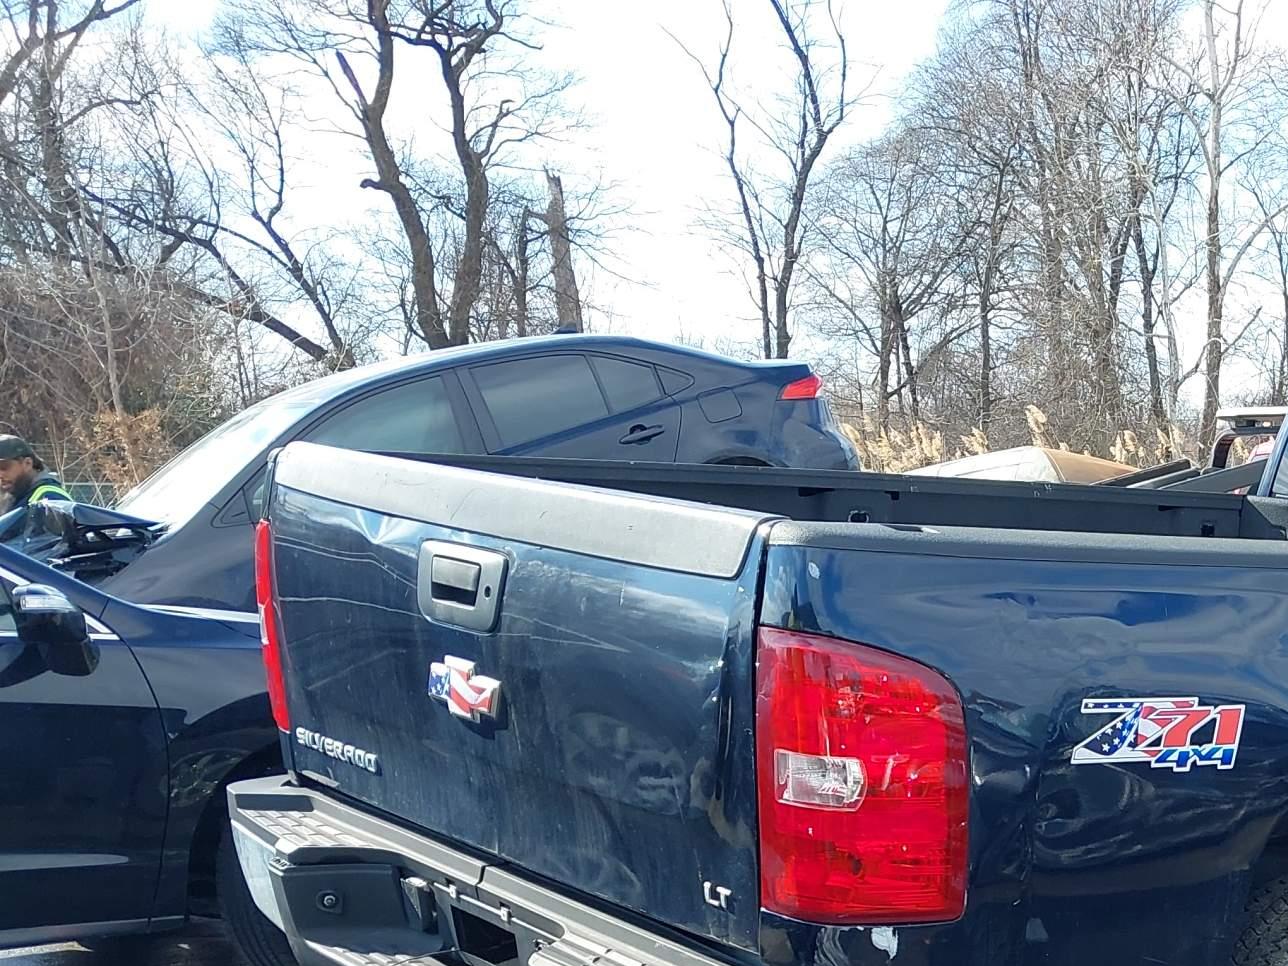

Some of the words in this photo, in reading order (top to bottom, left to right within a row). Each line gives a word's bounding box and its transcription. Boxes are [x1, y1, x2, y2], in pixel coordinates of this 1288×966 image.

[295, 726, 378, 773] SILVERADO
[1070, 697, 1246, 765] Z71
[703, 881, 732, 909] LT
